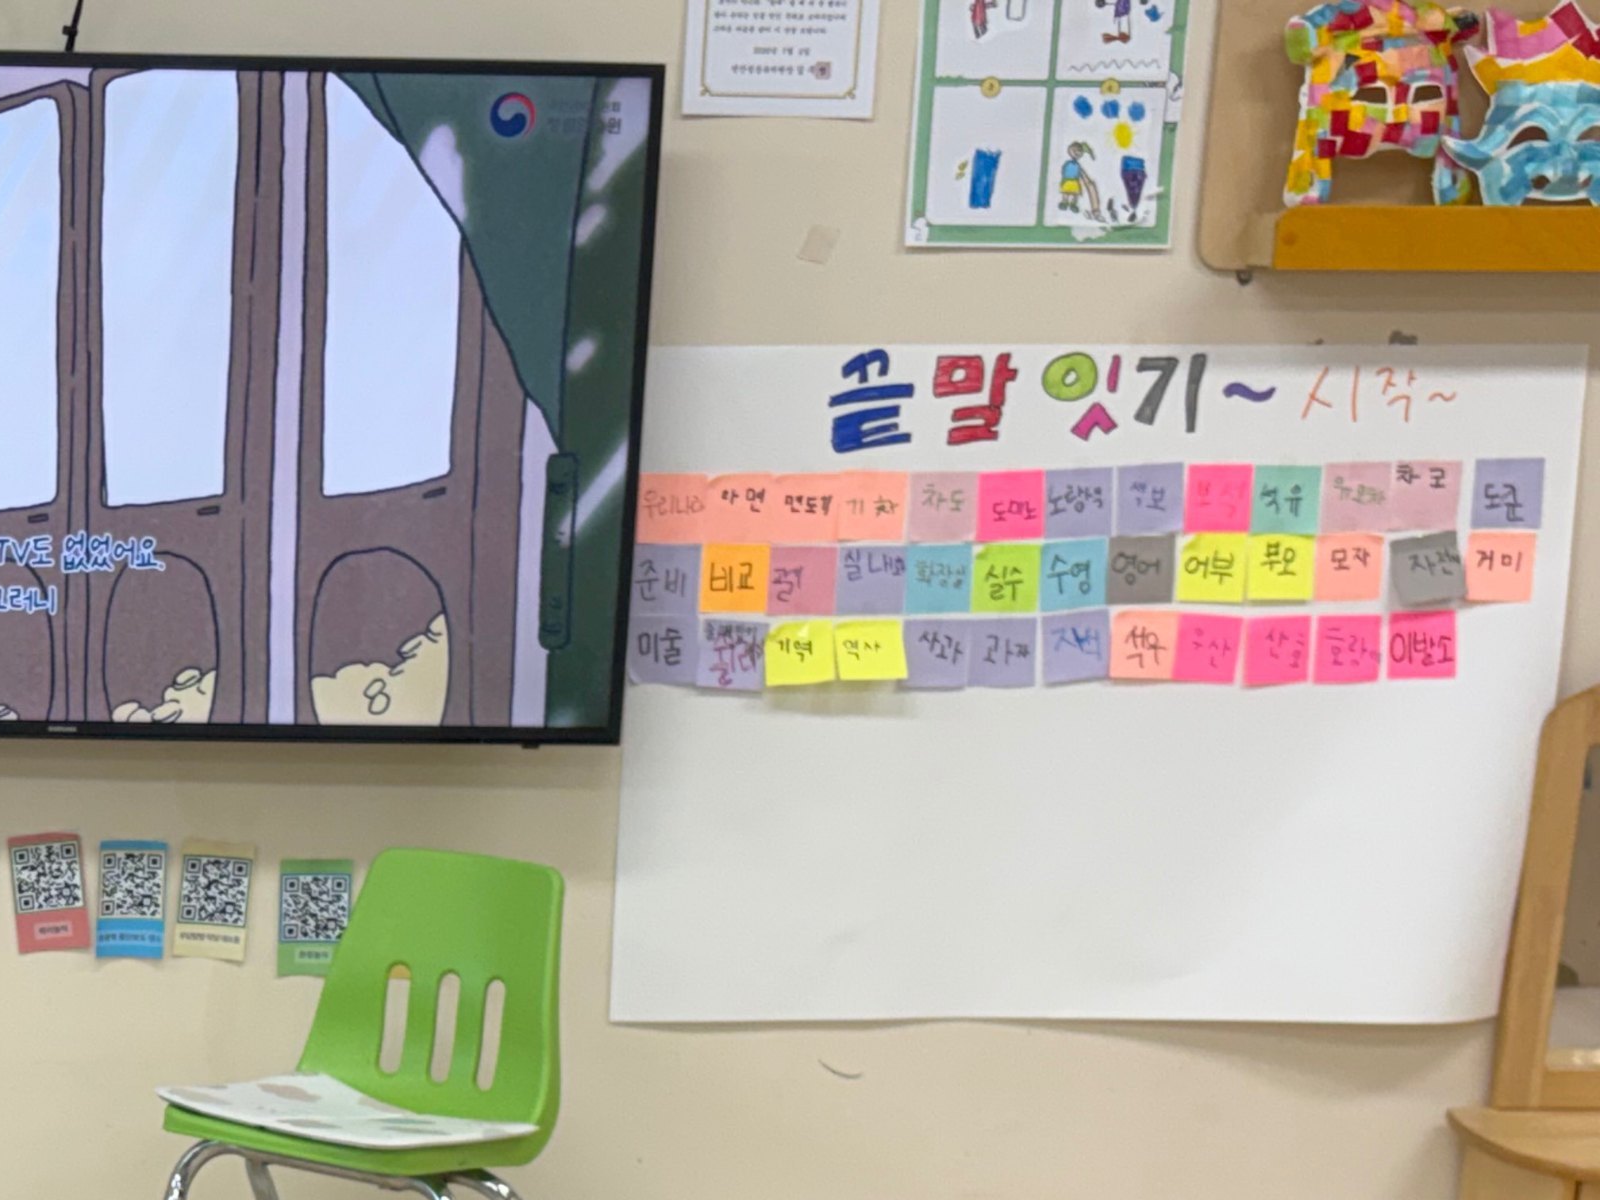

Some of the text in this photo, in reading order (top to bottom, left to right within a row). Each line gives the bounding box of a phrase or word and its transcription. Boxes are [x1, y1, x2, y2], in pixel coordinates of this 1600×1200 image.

[642, 489, 705, 520] 우리나라
[846, 496, 899, 516] 기차
[922, 483, 967, 512] 차도
[992, 500, 1037, 522] 도미노
[61, 533, 166, 575] 없었어요.
[634, 559, 687, 601] 준비
[708, 562, 755, 593] 비교
[984, 563, 1025, 601] 실수
[1046, 554, 1092, 595] 수영
[1111, 552, 1160, 585] 영어
[1184, 550, 1235, 585] 어부
[1330, 547, 1371, 571] 모자
[1476, 549, 1523, 573] 거미
[637, 627, 683, 667] 미술
[777, 637, 813, 663] 기역
[843, 639, 882, 661] 역사
[918, 630, 964, 665] 사과
[983, 634, 1031, 665] 과자
[1190, 627, 1231, 669] 우산
[1390, 631, 1454, 667] 이발소
